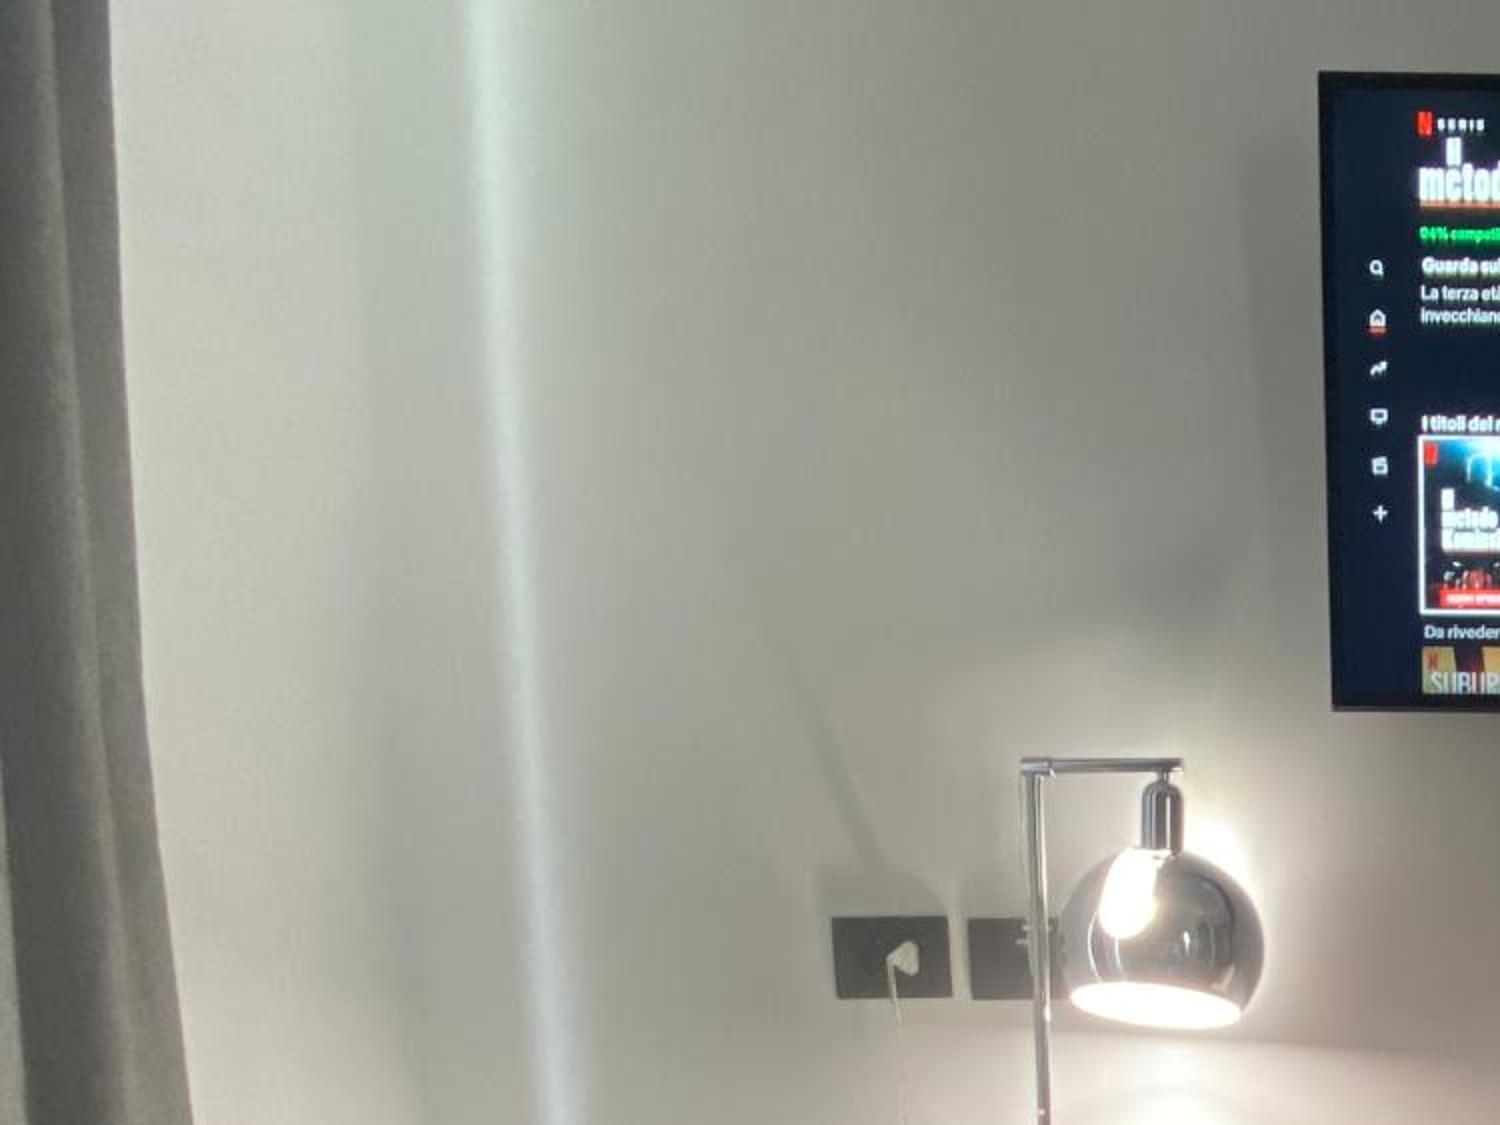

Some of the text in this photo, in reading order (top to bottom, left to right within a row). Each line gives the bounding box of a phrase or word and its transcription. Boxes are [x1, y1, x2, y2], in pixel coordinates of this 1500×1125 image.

[1422, 256, 1478, 275] Guarda
[1420, 285, 1439, 301] La
[1441, 286, 1479, 301] terza
[1429, 415, 1467, 432] titoli
[1468, 416, 1492, 432] del
[1424, 625, 1445, 639] Da
